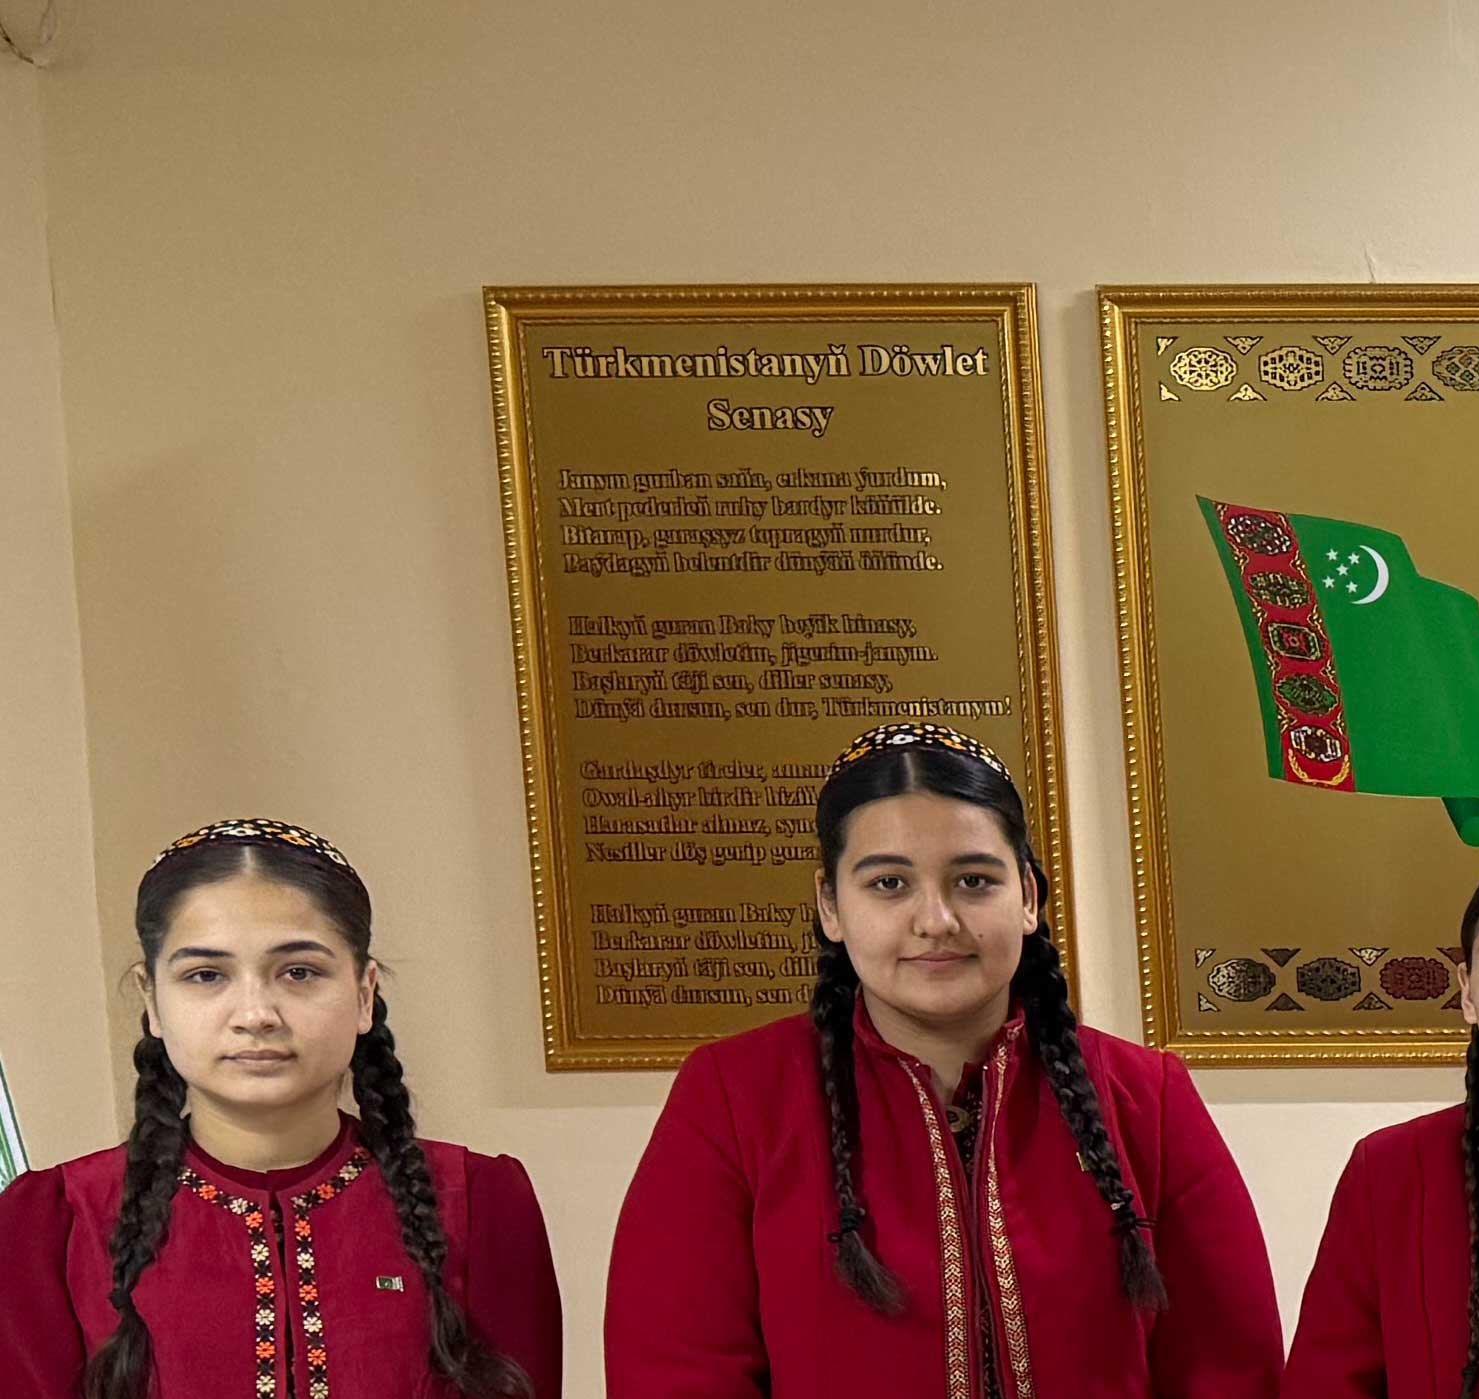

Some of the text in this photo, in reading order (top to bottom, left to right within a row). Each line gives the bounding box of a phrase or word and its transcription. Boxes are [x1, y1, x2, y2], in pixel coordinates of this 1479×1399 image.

[543, 343, 989, 384] Türkmenistanyň Döwlet
[707, 398, 833, 436] Senasy
[822, 696, 1012, 721] Türkmenistanym!
